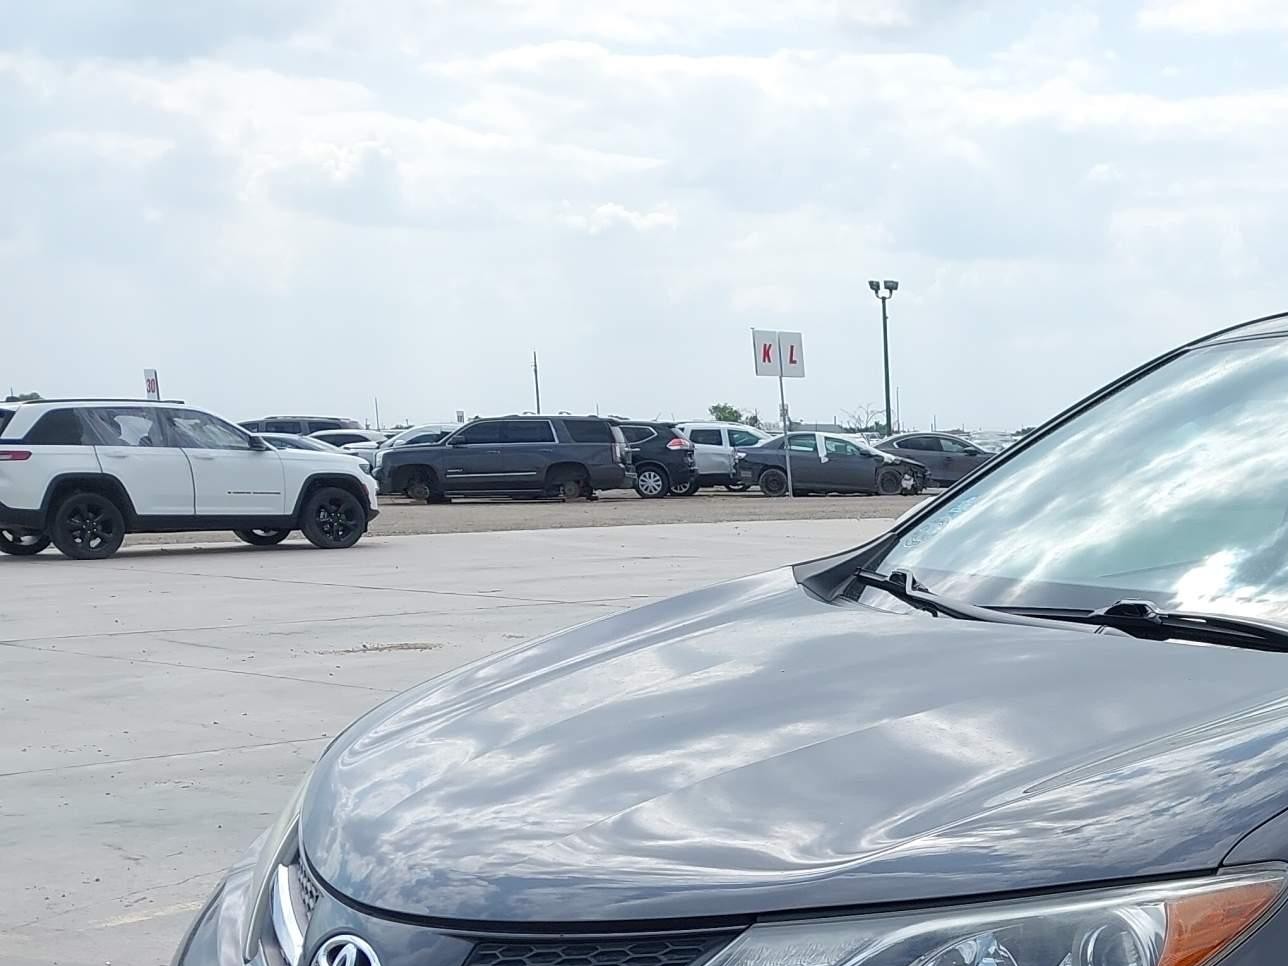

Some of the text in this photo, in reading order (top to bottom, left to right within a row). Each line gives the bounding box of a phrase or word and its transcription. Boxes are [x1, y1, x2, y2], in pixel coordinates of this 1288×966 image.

[762, 343, 797, 364] K L
[146, 378, 156, 393] 30
